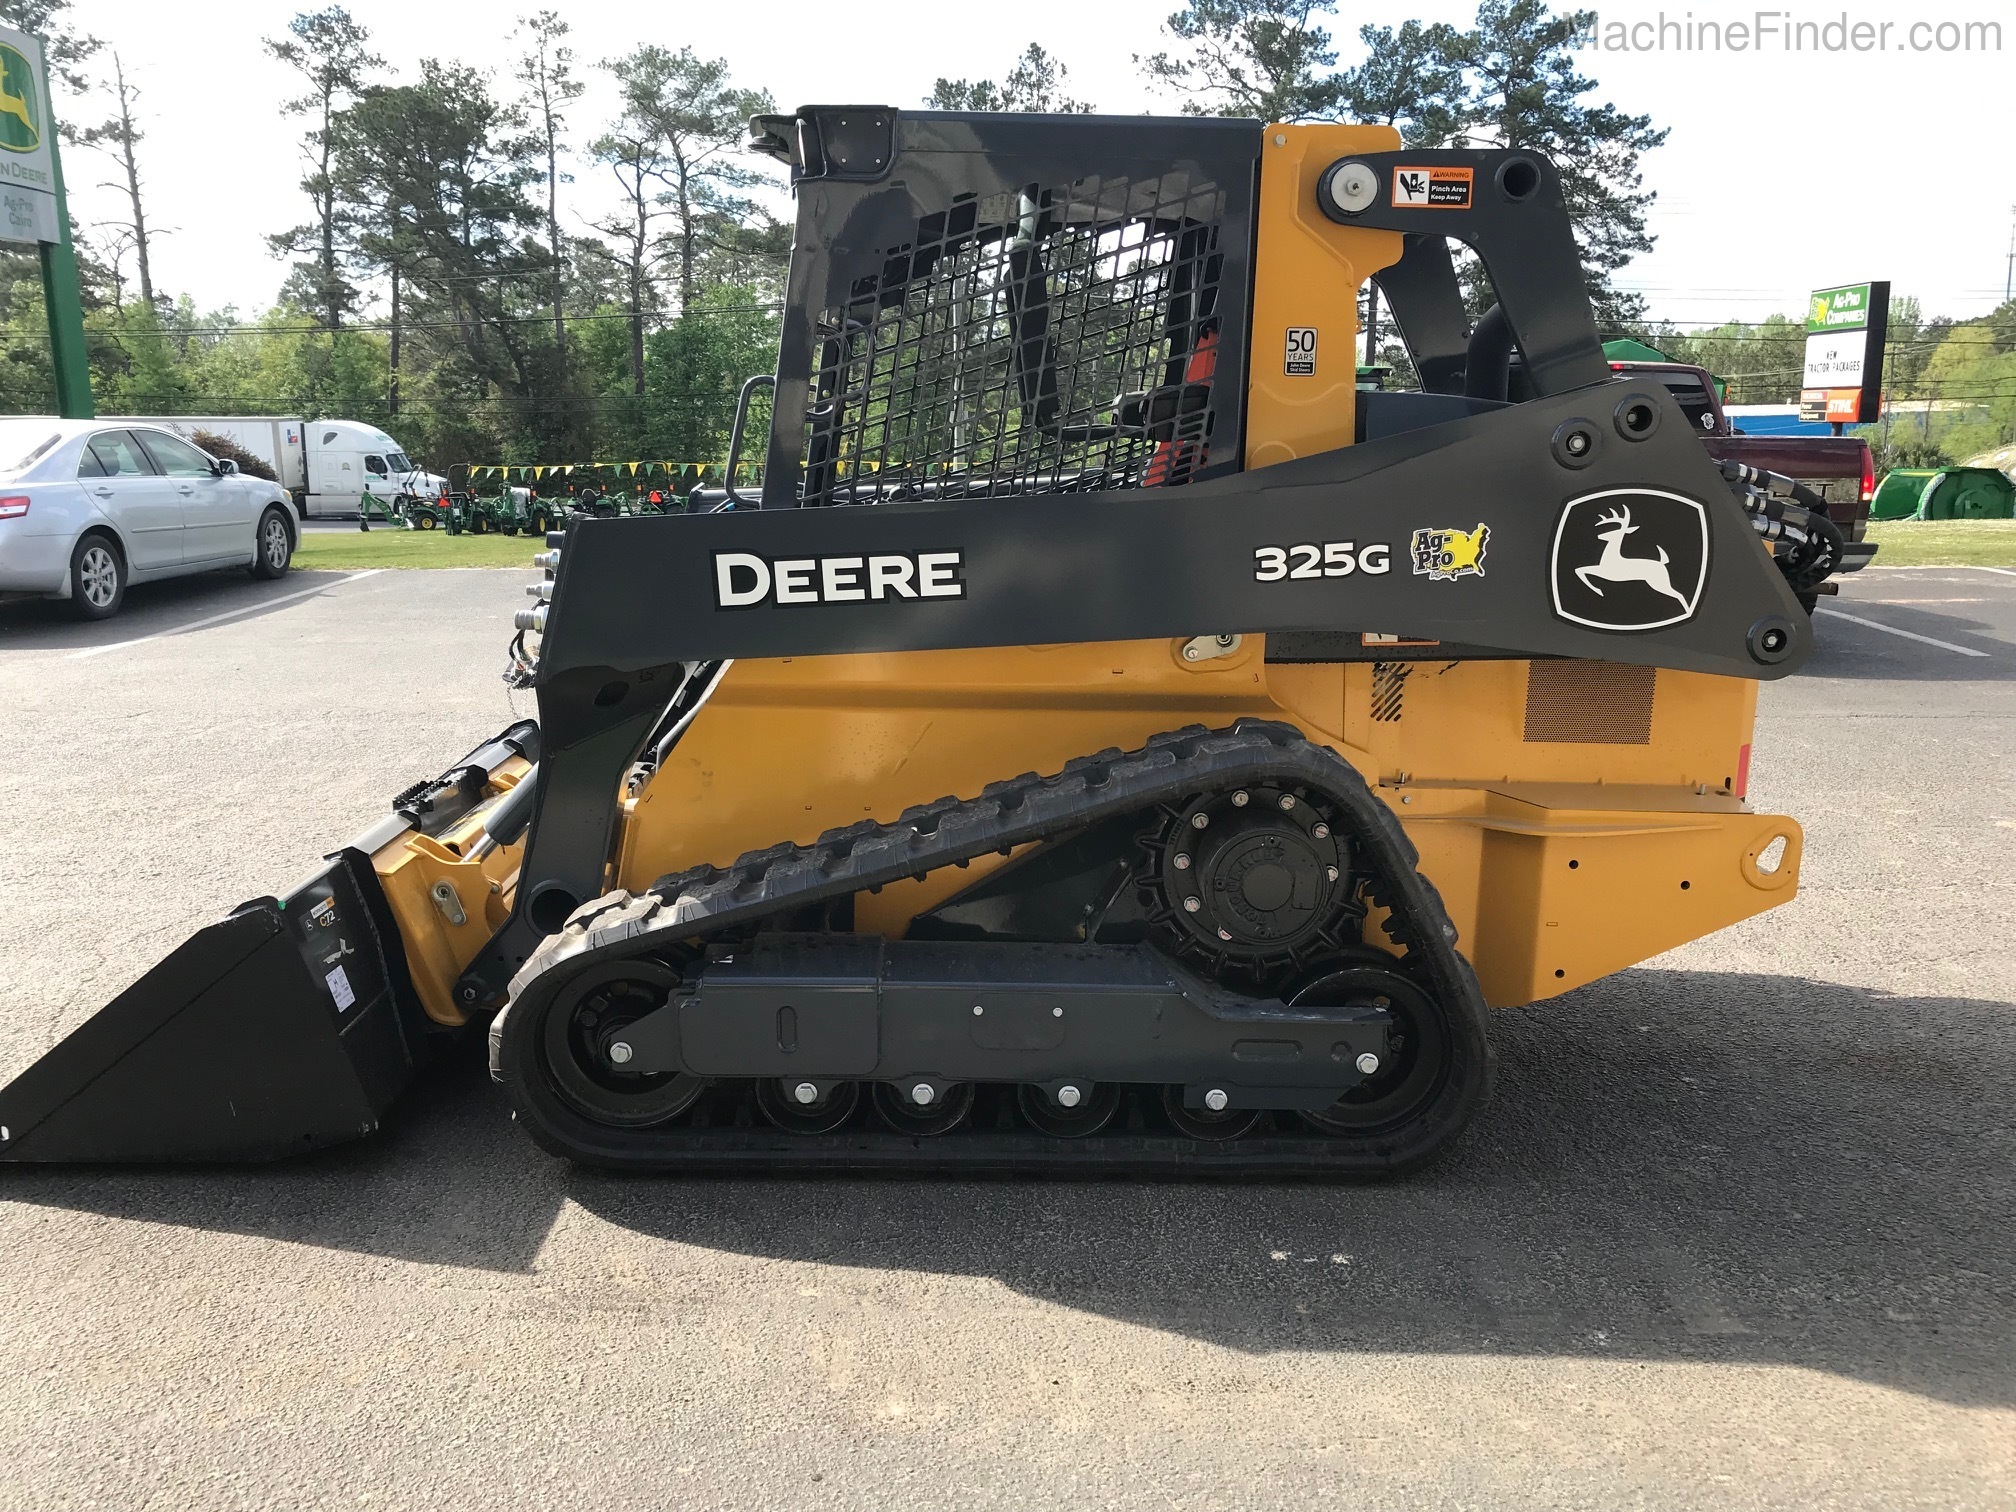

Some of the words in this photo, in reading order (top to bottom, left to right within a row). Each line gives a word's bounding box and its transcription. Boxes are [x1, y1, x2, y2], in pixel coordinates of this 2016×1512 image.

[11, 161, 48, 185] DEERE
[1287, 330, 1315, 352] 50
[1287, 352, 1314, 361] YEARS
[1826, 350, 1837, 360] NEW
[1808, 362, 1829, 373] TRACTOR
[1833, 360, 1860, 372] PACKAGES
[1828, 399, 1854, 413] STIHL
[1255, 542, 1390, 581] 325G
[1417, 550, 1454, 570] Pro
[716, 552, 962, 607] DEERE
[319, 910, 336, 927] C72
